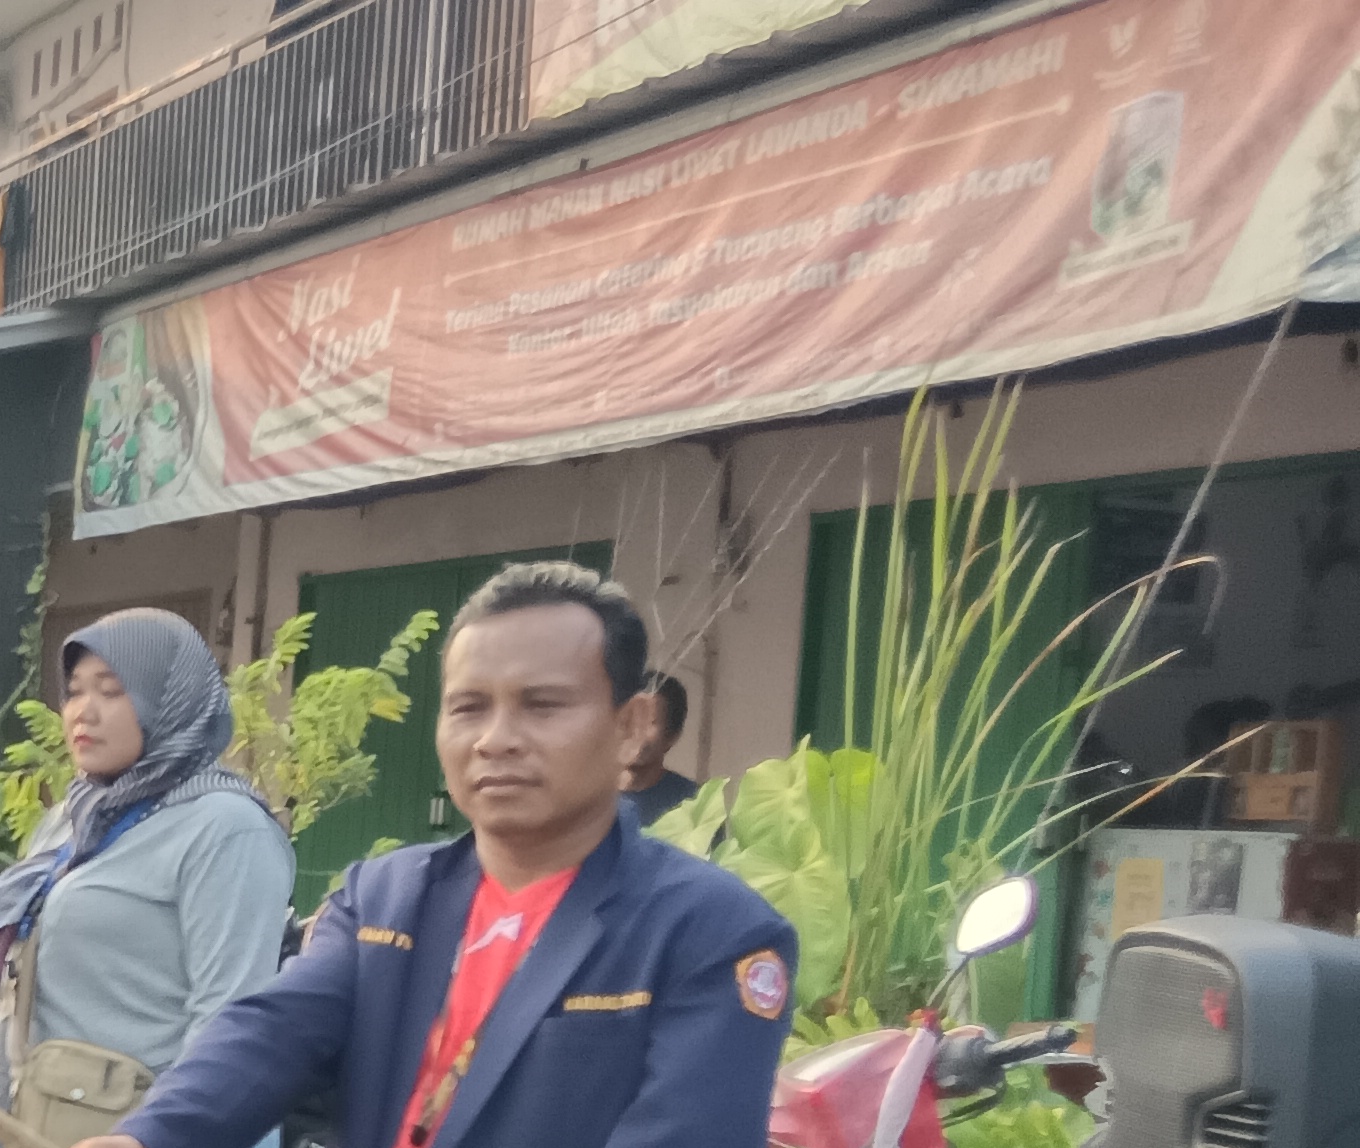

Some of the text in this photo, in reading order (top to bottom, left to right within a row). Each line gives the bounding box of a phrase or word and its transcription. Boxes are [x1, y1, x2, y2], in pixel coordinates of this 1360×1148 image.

[896, 32, 1069, 119] SUKAMAHI
[959, 157, 1053, 203] Acara
[290, 253, 362, 336] Nasi
